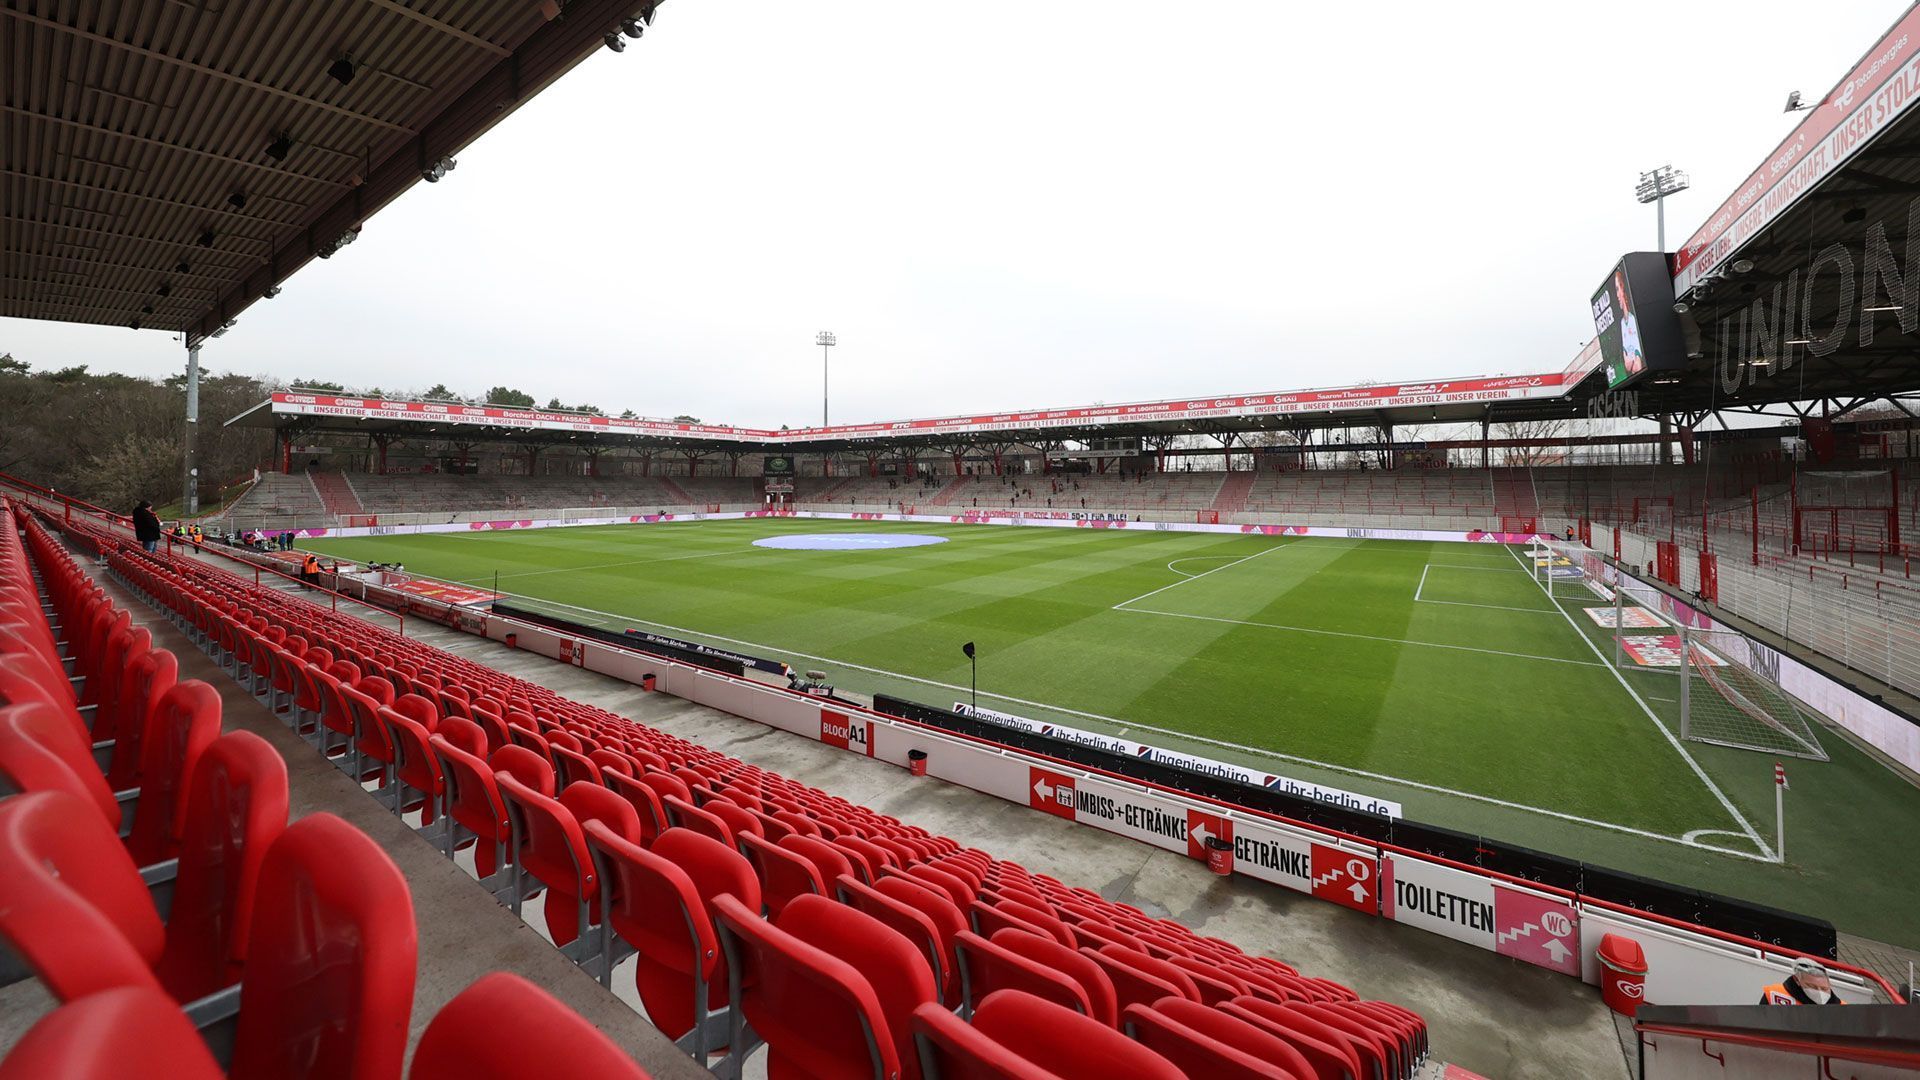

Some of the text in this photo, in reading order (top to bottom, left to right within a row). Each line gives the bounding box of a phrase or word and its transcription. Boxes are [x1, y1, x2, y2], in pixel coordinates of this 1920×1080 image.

[1855, 34, 1909, 90] TotalEnergies
[1695, 249, 1715, 278] UNSERE
[1735, 204, 1763, 242] UNSERE
[1832, 104, 1873, 161] UNSER
[1720, 196, 1920, 395] UNION
[313, 406, 344, 415] UNSERE
[371, 410, 399, 418] UNSERE
[1089, 408, 1119, 416] LOGISTIKER
[1254, 405, 1279, 413] UNSERE
[1303, 402, 1331, 410] UNSERE
[1388, 396, 1415, 405] UNSER
[1446, 393, 1474, 402] UNSER
[1476, 391, 1511, 401] VEREIN.
[502, 411, 534, 419] Borchert
[535, 413, 555, 421] DACH
[561, 415, 591, 424] FASSADE
[979, 422, 1005, 430] STADION
[1033, 419, 1054, 427] ALTEN
[1108, 513, 1127, 521] ALLE!
[573, 647, 581, 660] A2
[966, 708, 1033, 732] Ingenieurbüro
[823, 722, 867, 745] BLOCK A1
[1155, 751, 1250, 783] Ingenieurbüro
[1076, 789, 1188, 842] IMBISS+GETRÄNKE
[1234, 835, 1311, 880] GETRÄNKE
[1395, 879, 1494, 934] TOILETTEN
[1546, 914, 1567, 935] WC
